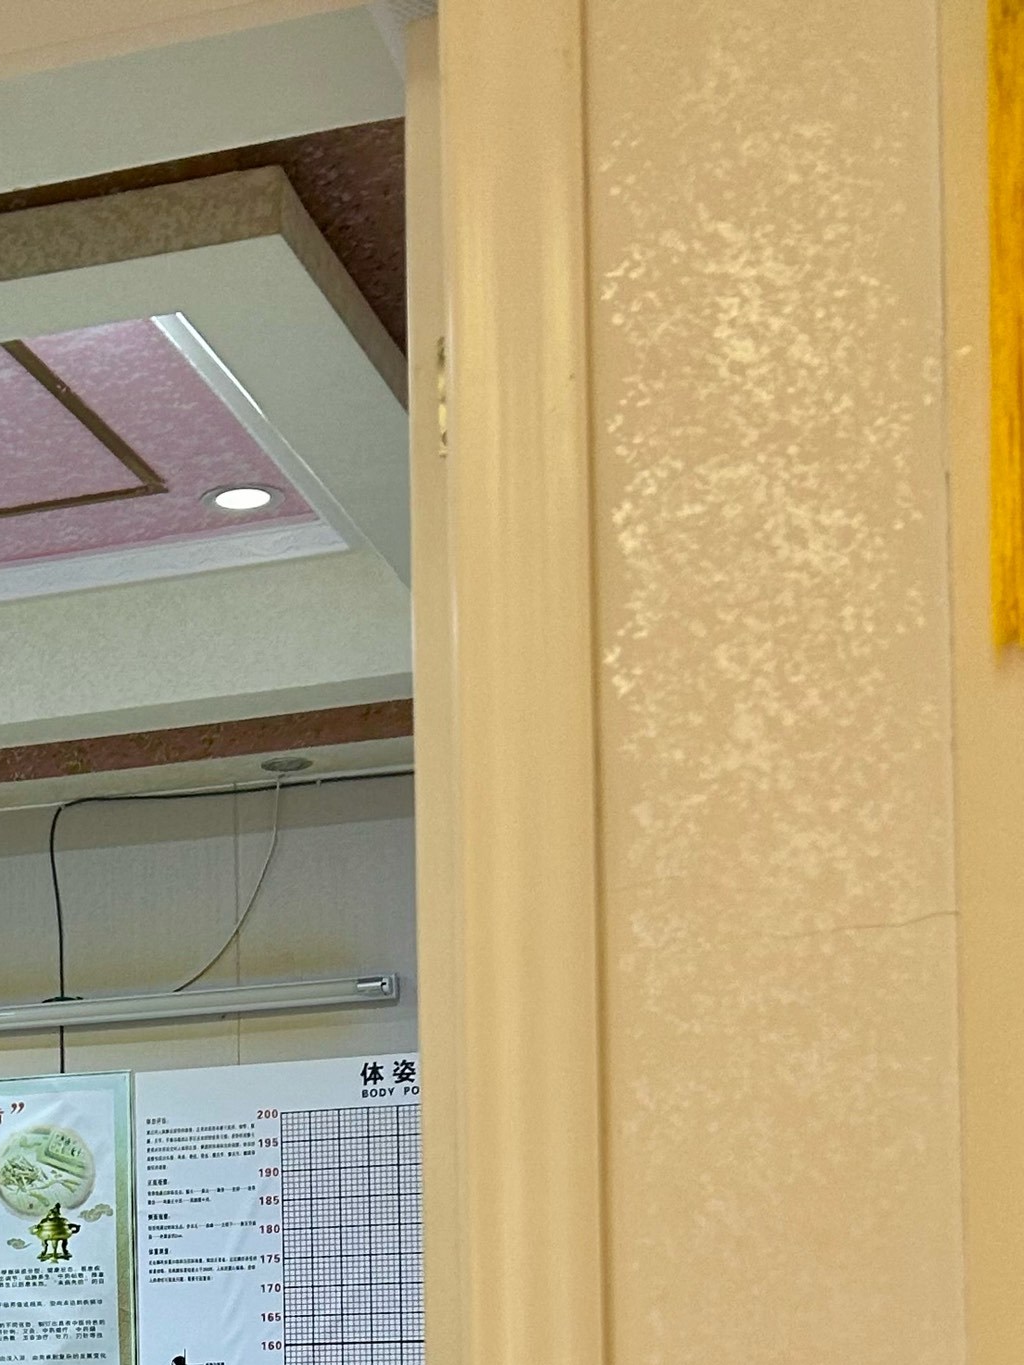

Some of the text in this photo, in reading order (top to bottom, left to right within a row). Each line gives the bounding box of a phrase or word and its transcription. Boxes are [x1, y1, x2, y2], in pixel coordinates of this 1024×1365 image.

[360, 1059, 417, 1086] 体姿
[361, 1087, 395, 1098] BODY
[257, 1109, 278, 1119] 200
[259, 1138, 278, 1147] 195
[259, 1168, 279, 1177] 190
[259, 1196, 279, 1205] 185
[259, 1224, 280, 1234] 180
[260, 1254, 280, 1263] 175
[261, 1283, 281, 1293] 170
[261, 1313, 281, 1322] 165
[262, 1341, 282, 1350] 160
